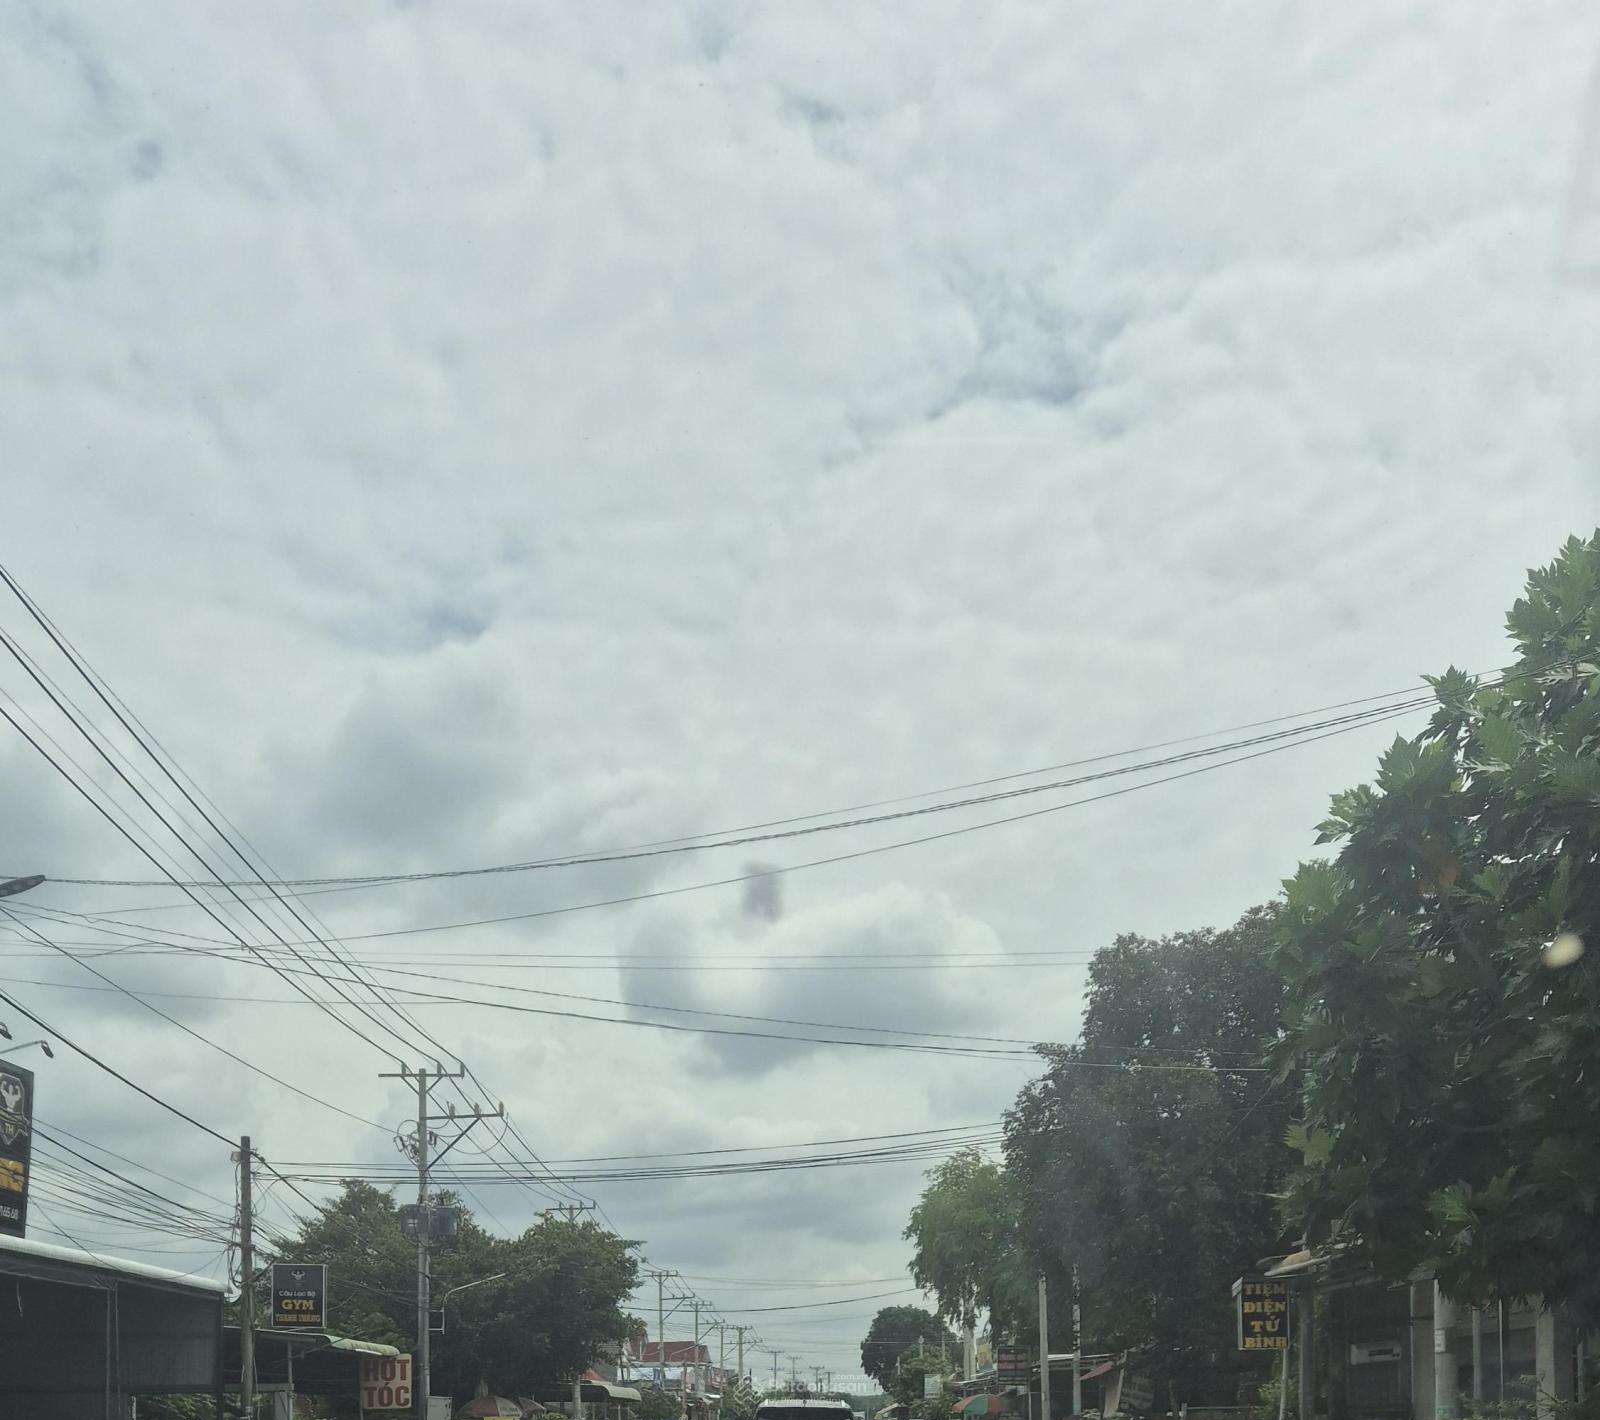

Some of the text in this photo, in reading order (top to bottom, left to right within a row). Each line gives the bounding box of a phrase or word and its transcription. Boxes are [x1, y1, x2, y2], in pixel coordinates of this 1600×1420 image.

[281, 1299, 314, 1310] GYM
[1243, 1298, 1286, 1315] ĐIỆN
[364, 1382, 409, 1407] TÓC
